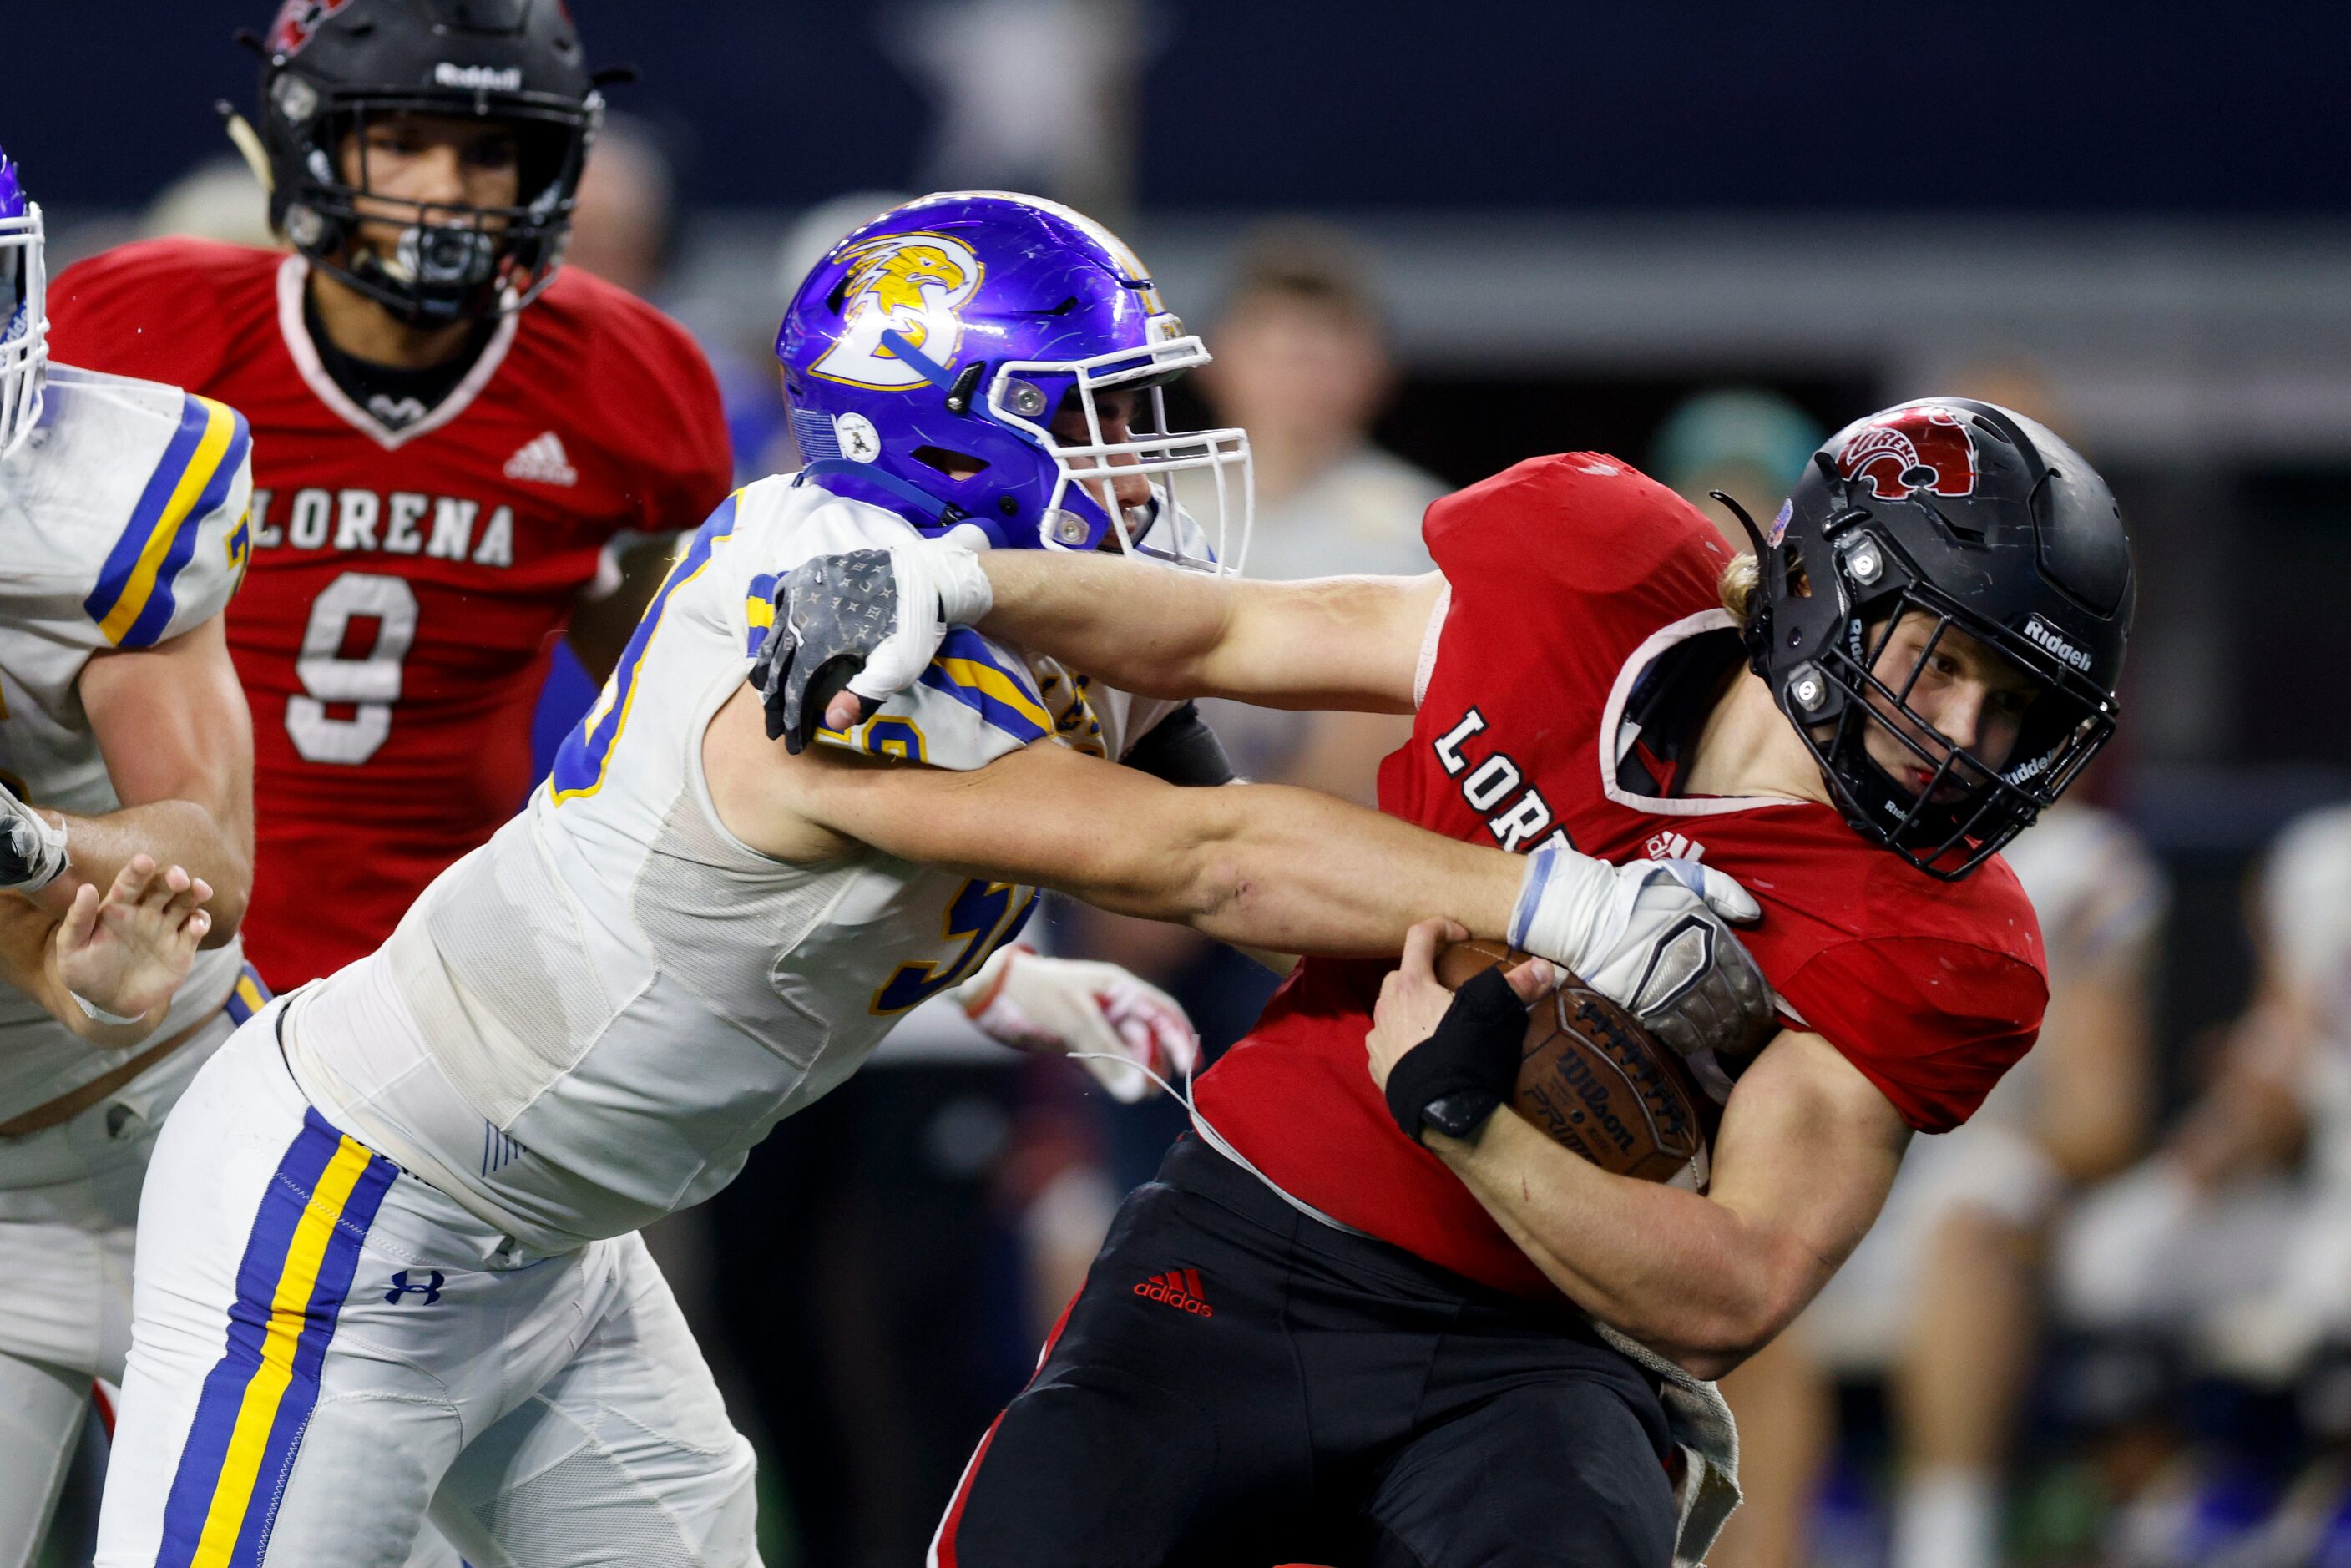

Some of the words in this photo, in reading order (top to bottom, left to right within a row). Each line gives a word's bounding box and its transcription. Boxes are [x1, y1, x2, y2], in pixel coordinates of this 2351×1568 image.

[251, 487, 514, 568] LORENA
[284, 571, 419, 766] 9
[1556, 1046, 1636, 1152] Wilson
[1132, 1282, 1214, 1318] adidas
